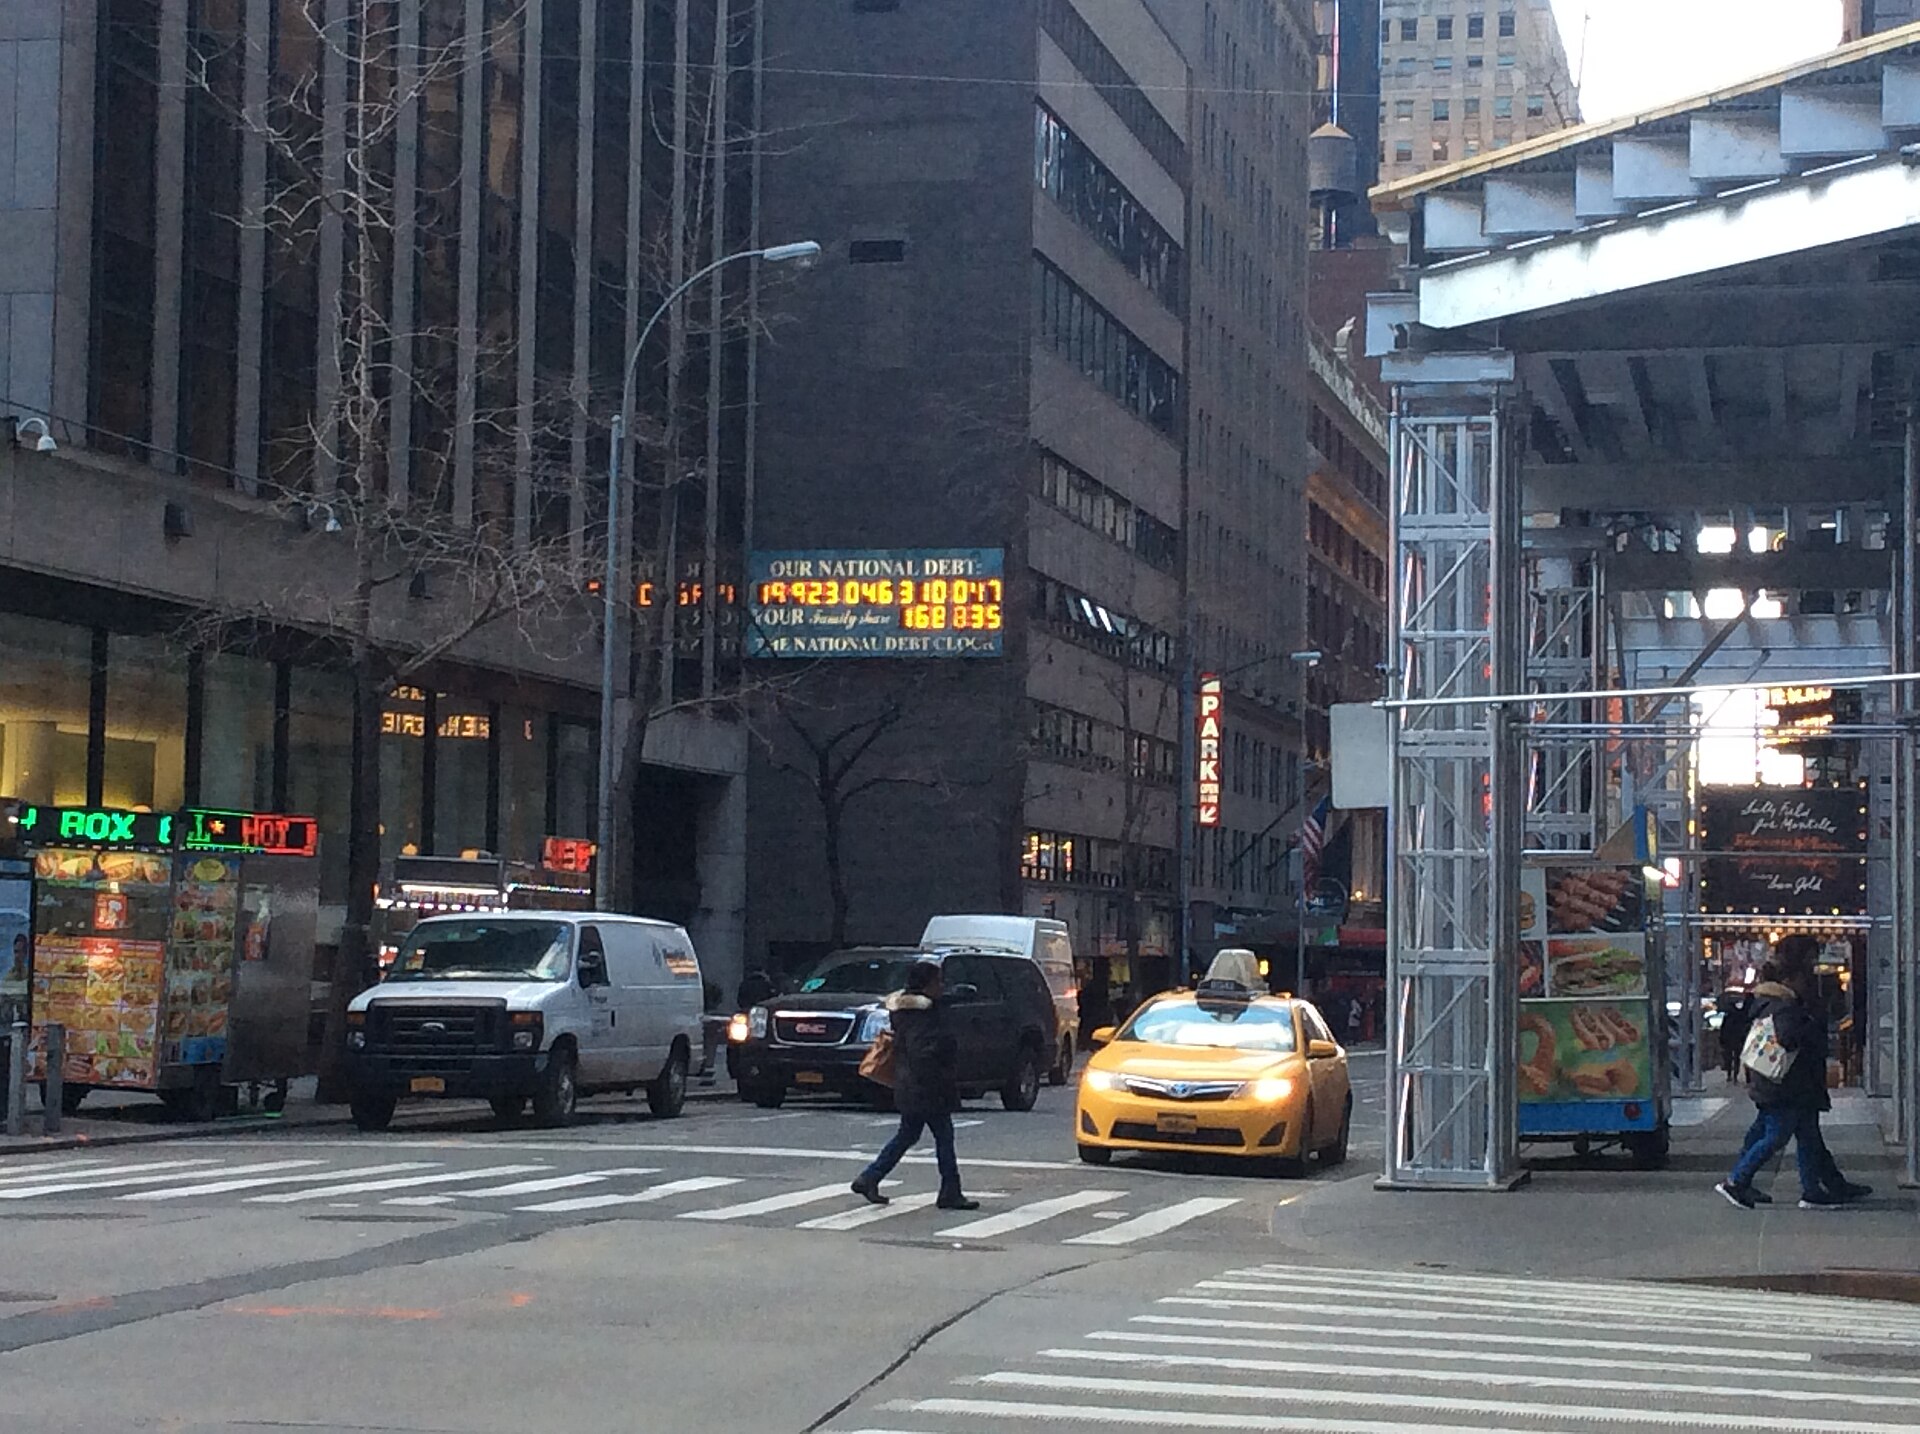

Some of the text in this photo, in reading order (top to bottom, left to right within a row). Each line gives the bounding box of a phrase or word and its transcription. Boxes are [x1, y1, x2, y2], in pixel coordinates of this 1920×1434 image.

[769, 559, 812, 577] OUR
[818, 559, 919, 577] NATIONAL
[751, 608, 804, 626] YOUR
[793, 637, 882, 652] NATIONAL
[885, 636, 930, 652] DEBT
[1200, 695, 1219, 782] PARK
